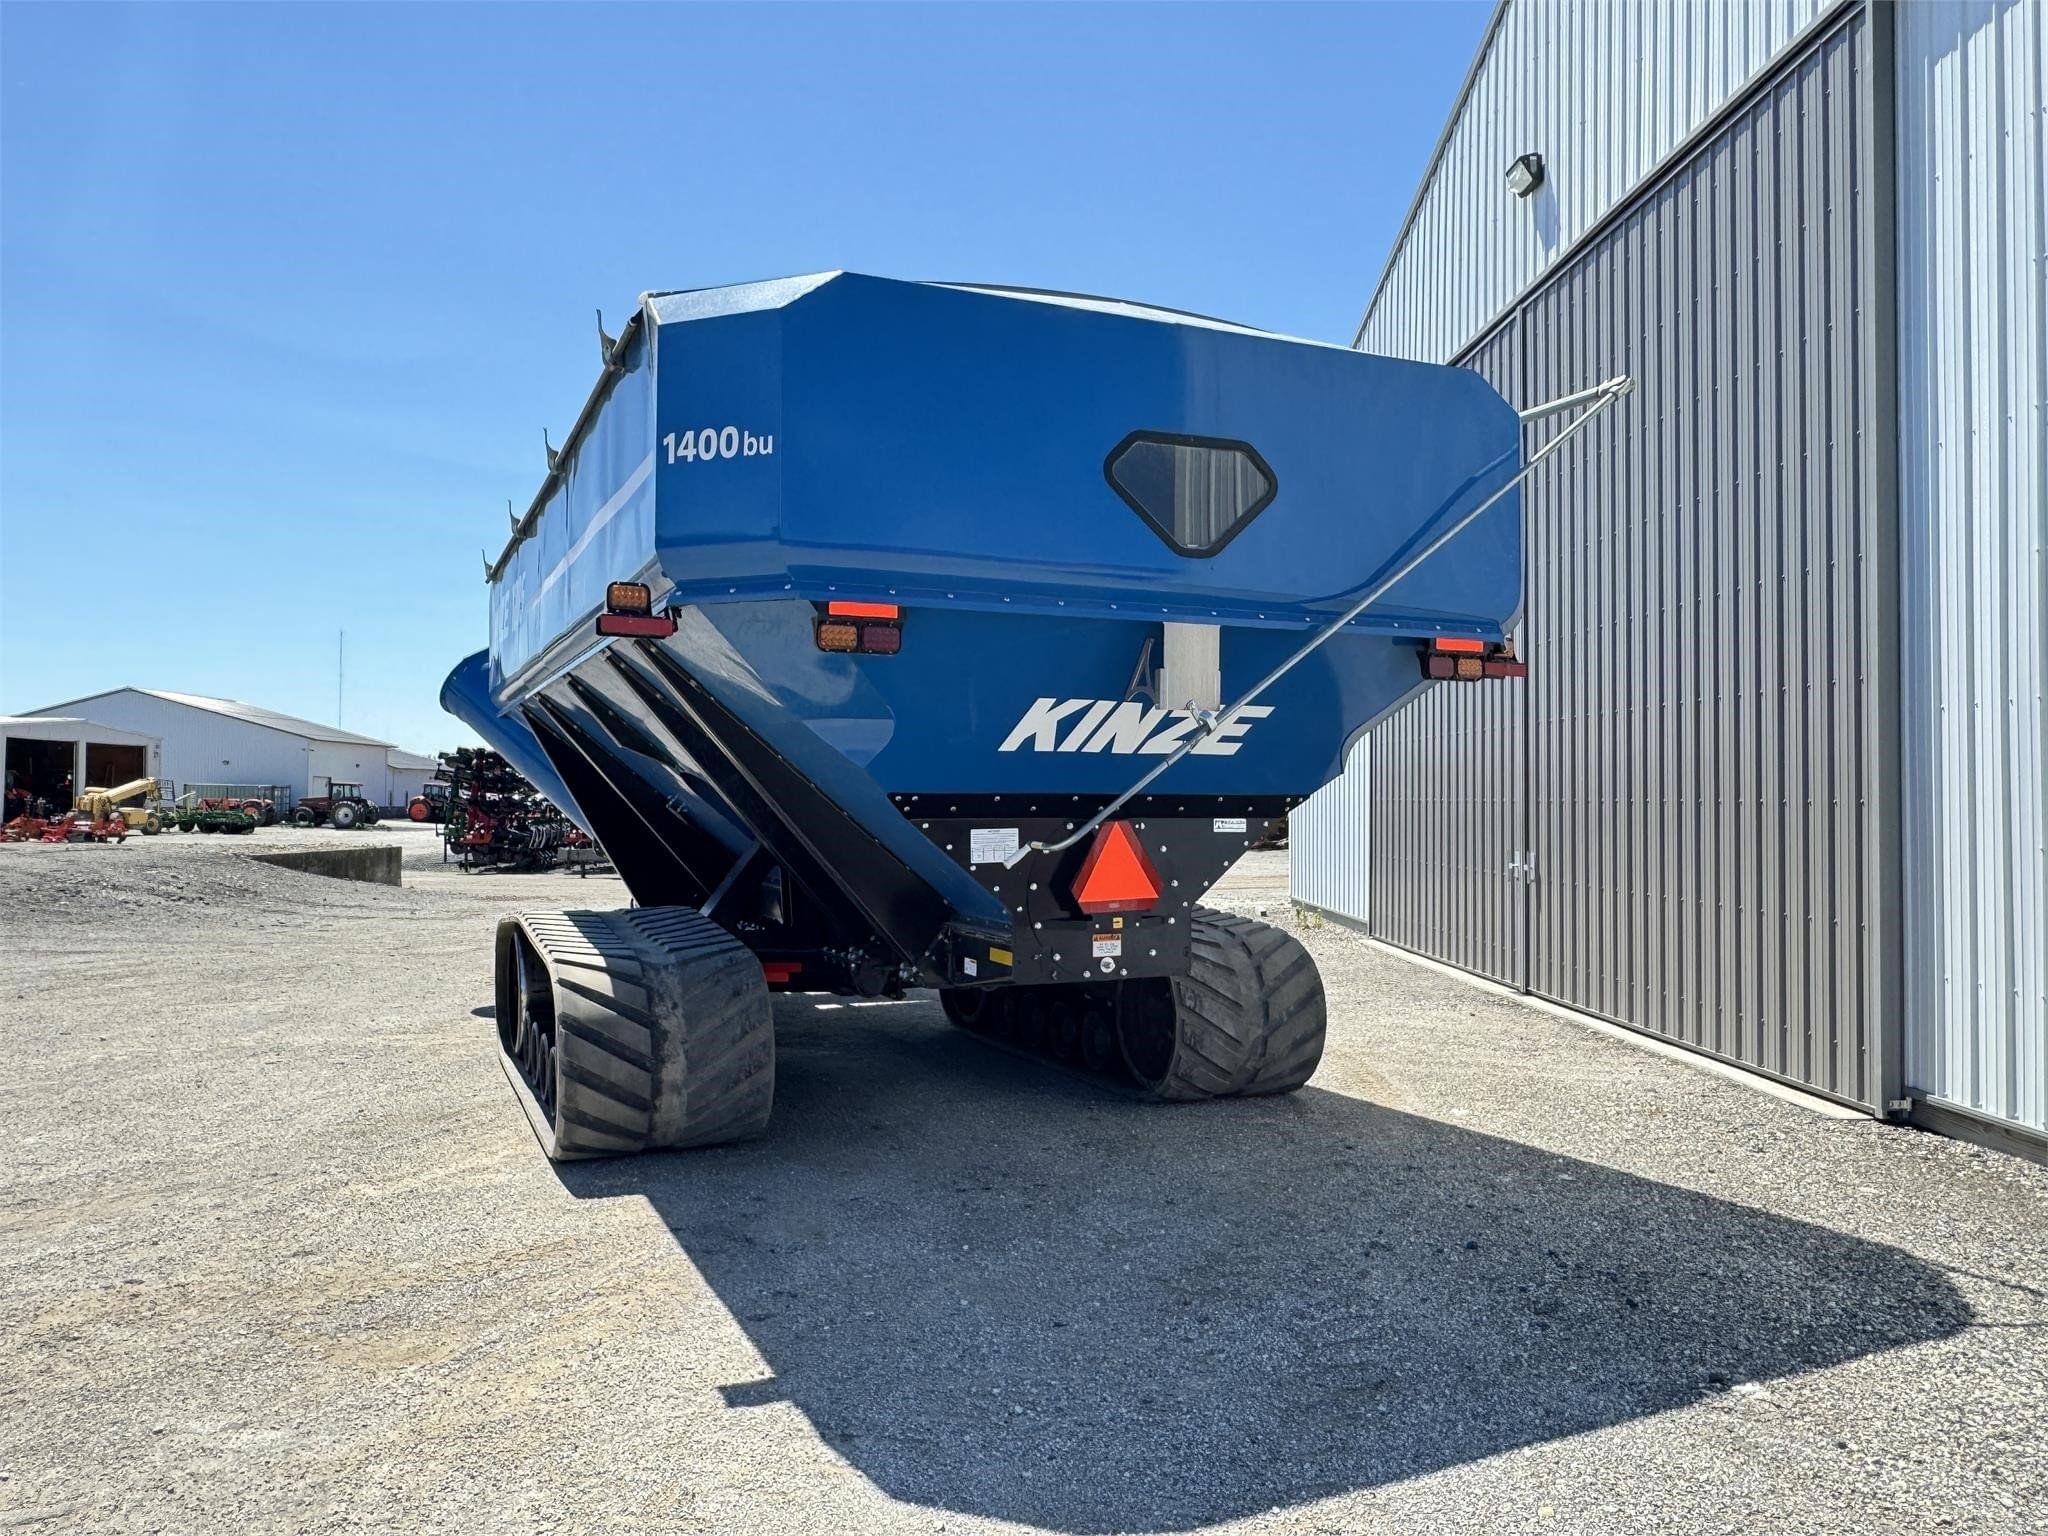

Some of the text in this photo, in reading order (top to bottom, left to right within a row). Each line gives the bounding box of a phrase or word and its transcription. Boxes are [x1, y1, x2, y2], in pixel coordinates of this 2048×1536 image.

[663, 426, 773, 464] 1400 bu
[998, 698, 1276, 755] KINZE
